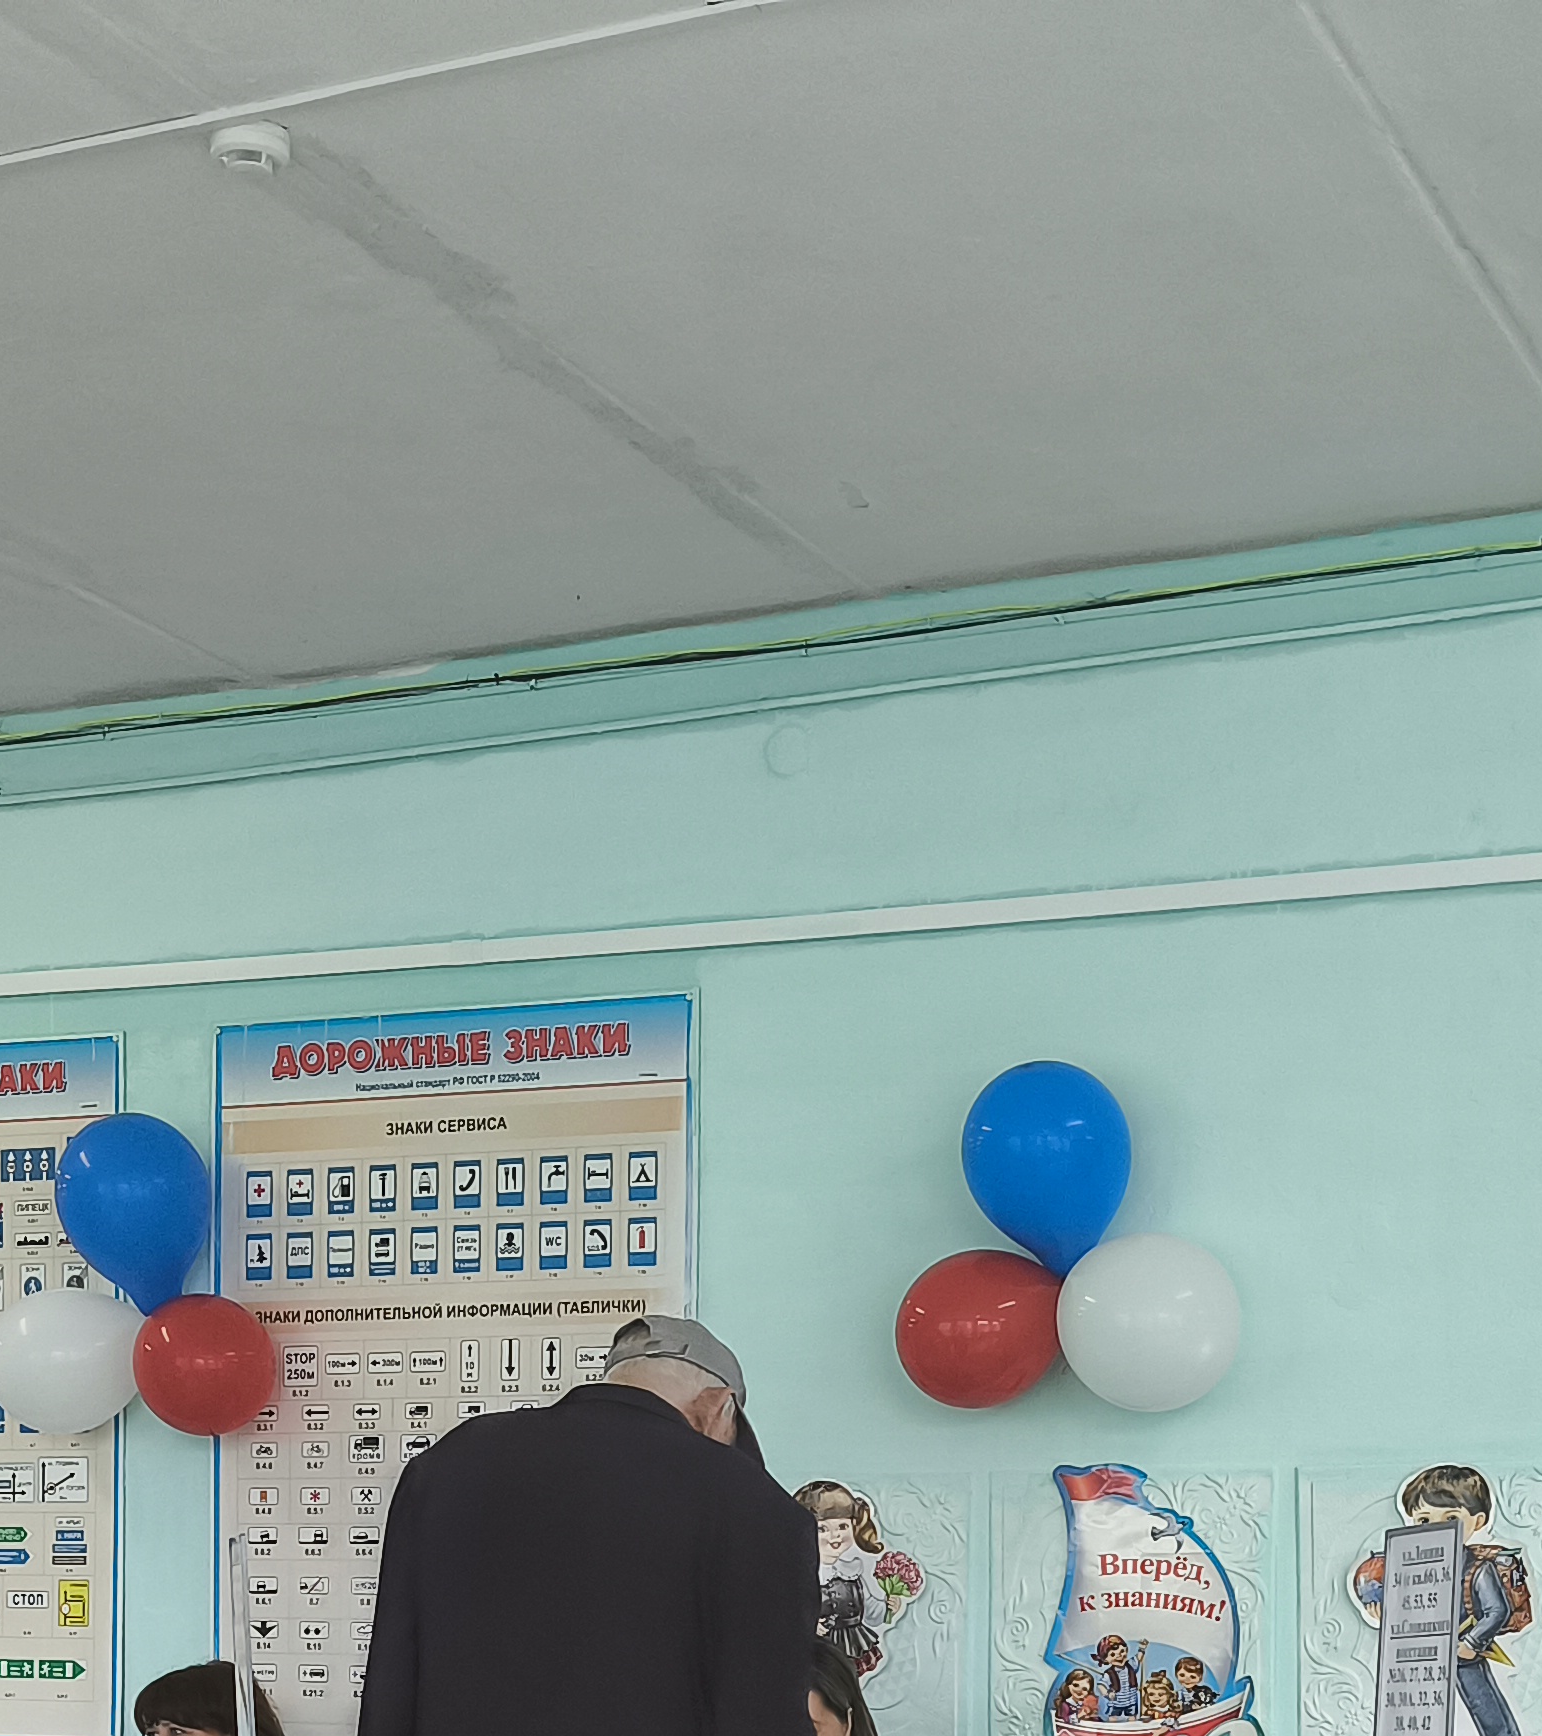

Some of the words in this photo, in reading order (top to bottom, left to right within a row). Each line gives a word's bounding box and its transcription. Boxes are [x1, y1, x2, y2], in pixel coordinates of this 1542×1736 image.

[272, 1030, 491, 1079] ДОРОЖНЫЕ
[503, 1022, 631, 1063] ЗНАКИ
[466, 1074, 489, 1085] ГОСТ
[385, 1121, 435, 1137] ЗНАКИ
[437, 1116, 508, 1134] СЕРВИСА
[544, 1236, 562, 1247] WC
[289, 1246, 311, 1257] ДПС
[303, 1303, 443, 1325] ДОПОЛНИТЕЛЬНОЙ
[446, 1302, 554, 1320] ИНФОРМАЦИИ
[556, 1299, 647, 1319] (ТАБЛИЧКИ)
[285, 1353, 316, 1365] STOP
[286, 1368, 316, 1380] 250м
[1097, 1552, 1212, 1590] Вперёд,
[11, 1592, 45, 1607] СТОП
[1078, 1593, 1096, 1613] к
[1100, 1590, 1227, 1623] знаниям!
